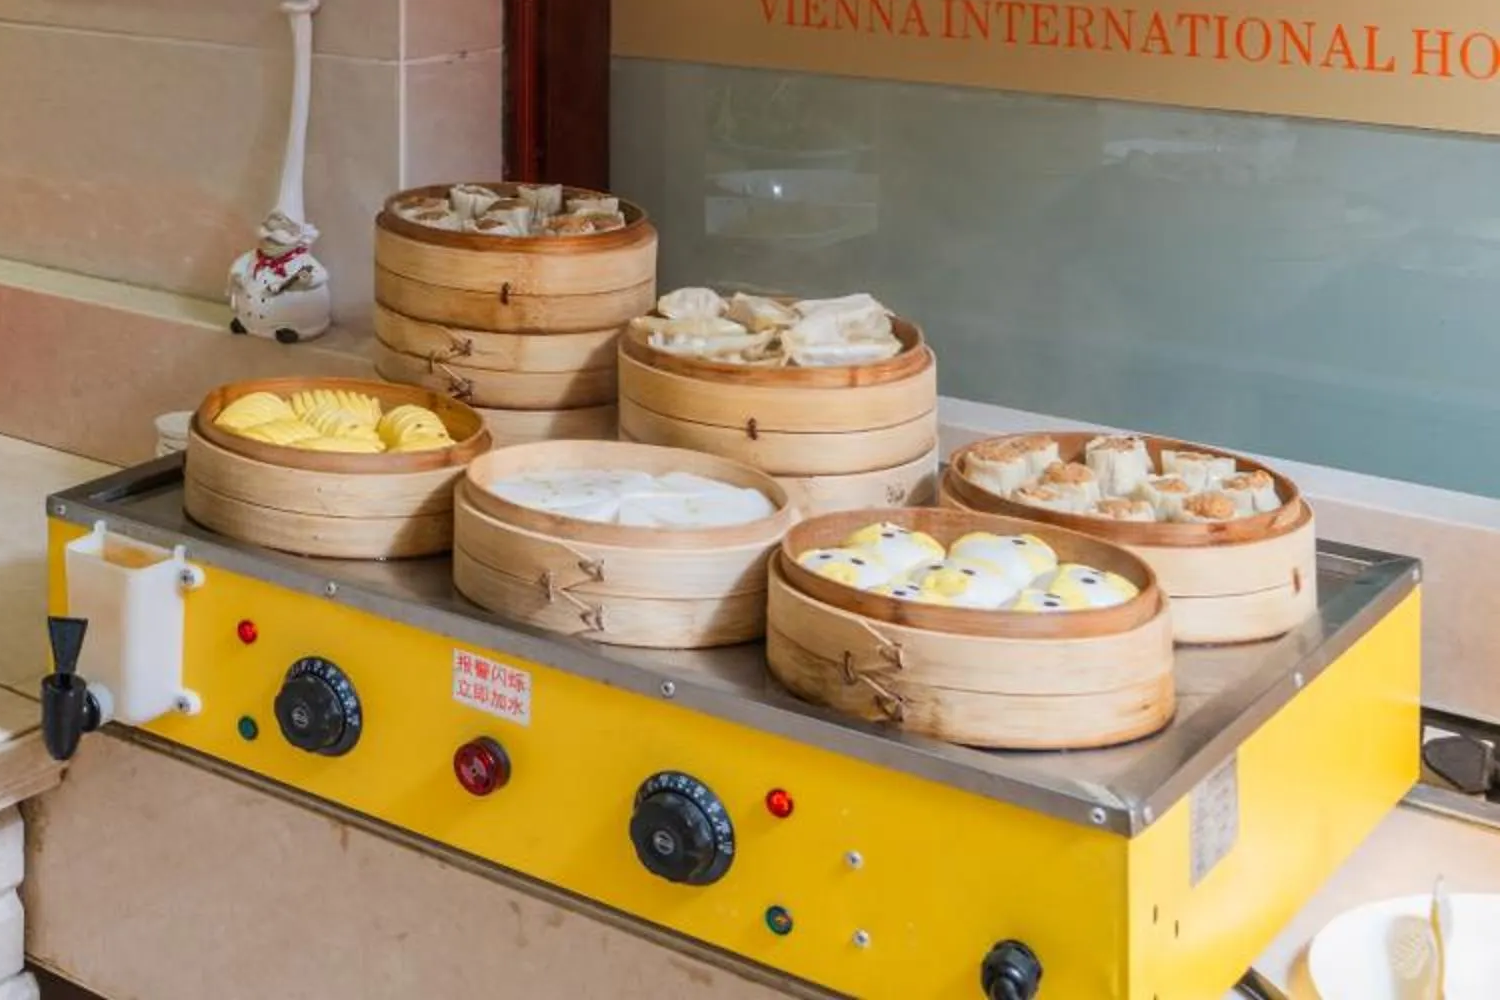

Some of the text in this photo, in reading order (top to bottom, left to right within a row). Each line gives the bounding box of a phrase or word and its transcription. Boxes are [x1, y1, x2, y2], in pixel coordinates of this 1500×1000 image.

[455, 655, 525, 693] 报警闪烁
[455, 679, 525, 716] 立即加水
